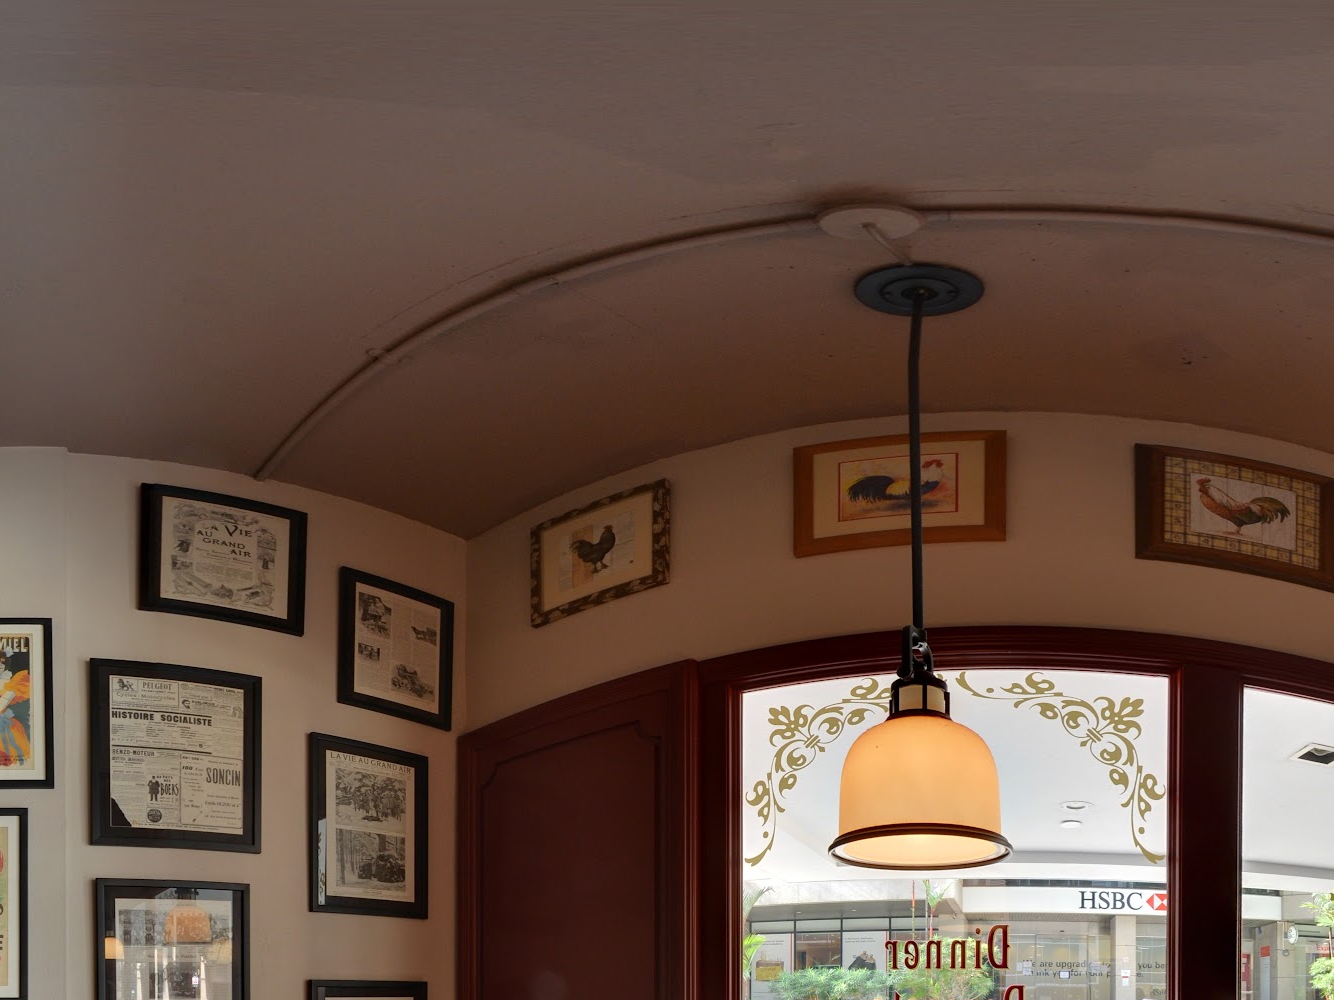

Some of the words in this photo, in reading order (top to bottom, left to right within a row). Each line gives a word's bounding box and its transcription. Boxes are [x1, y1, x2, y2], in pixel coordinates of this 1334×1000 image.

[202, 538, 246, 550] GRAND
[230, 549, 251, 558] AIR
[112, 710, 154, 720] HISTOIRE
[160, 714, 212, 726] SOCIALISTE
[343, 754, 356, 762] VIE
[371, 760, 398, 770] GRAND
[206, 768, 241, 786] SONCIN
[1079, 890, 1143, 910] HSBC
